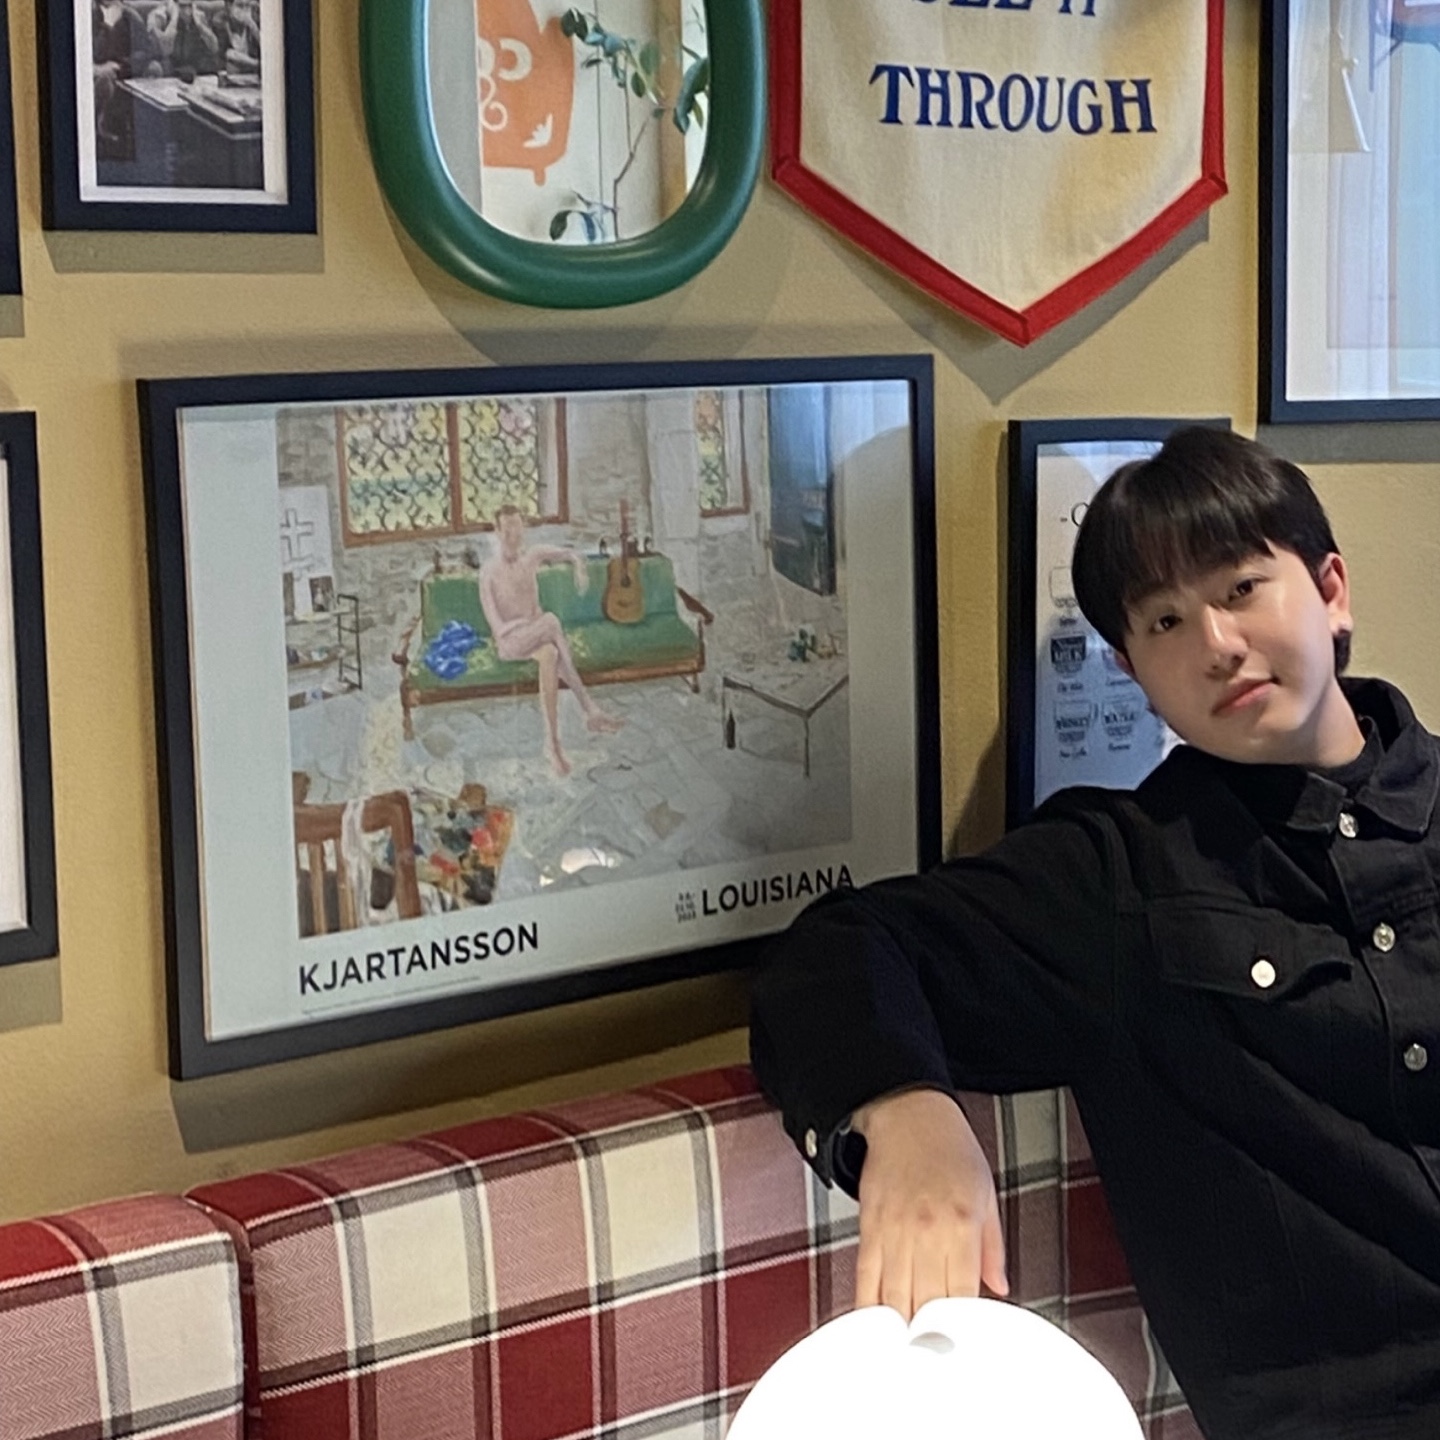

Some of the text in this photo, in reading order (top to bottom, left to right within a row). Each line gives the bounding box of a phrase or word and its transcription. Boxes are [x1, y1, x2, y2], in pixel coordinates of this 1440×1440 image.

[869, 63, 1157, 136] THROUGH
[702, 863, 854, 916] LOUISIANA
[299, 921, 539, 995] KJARTANSSON
